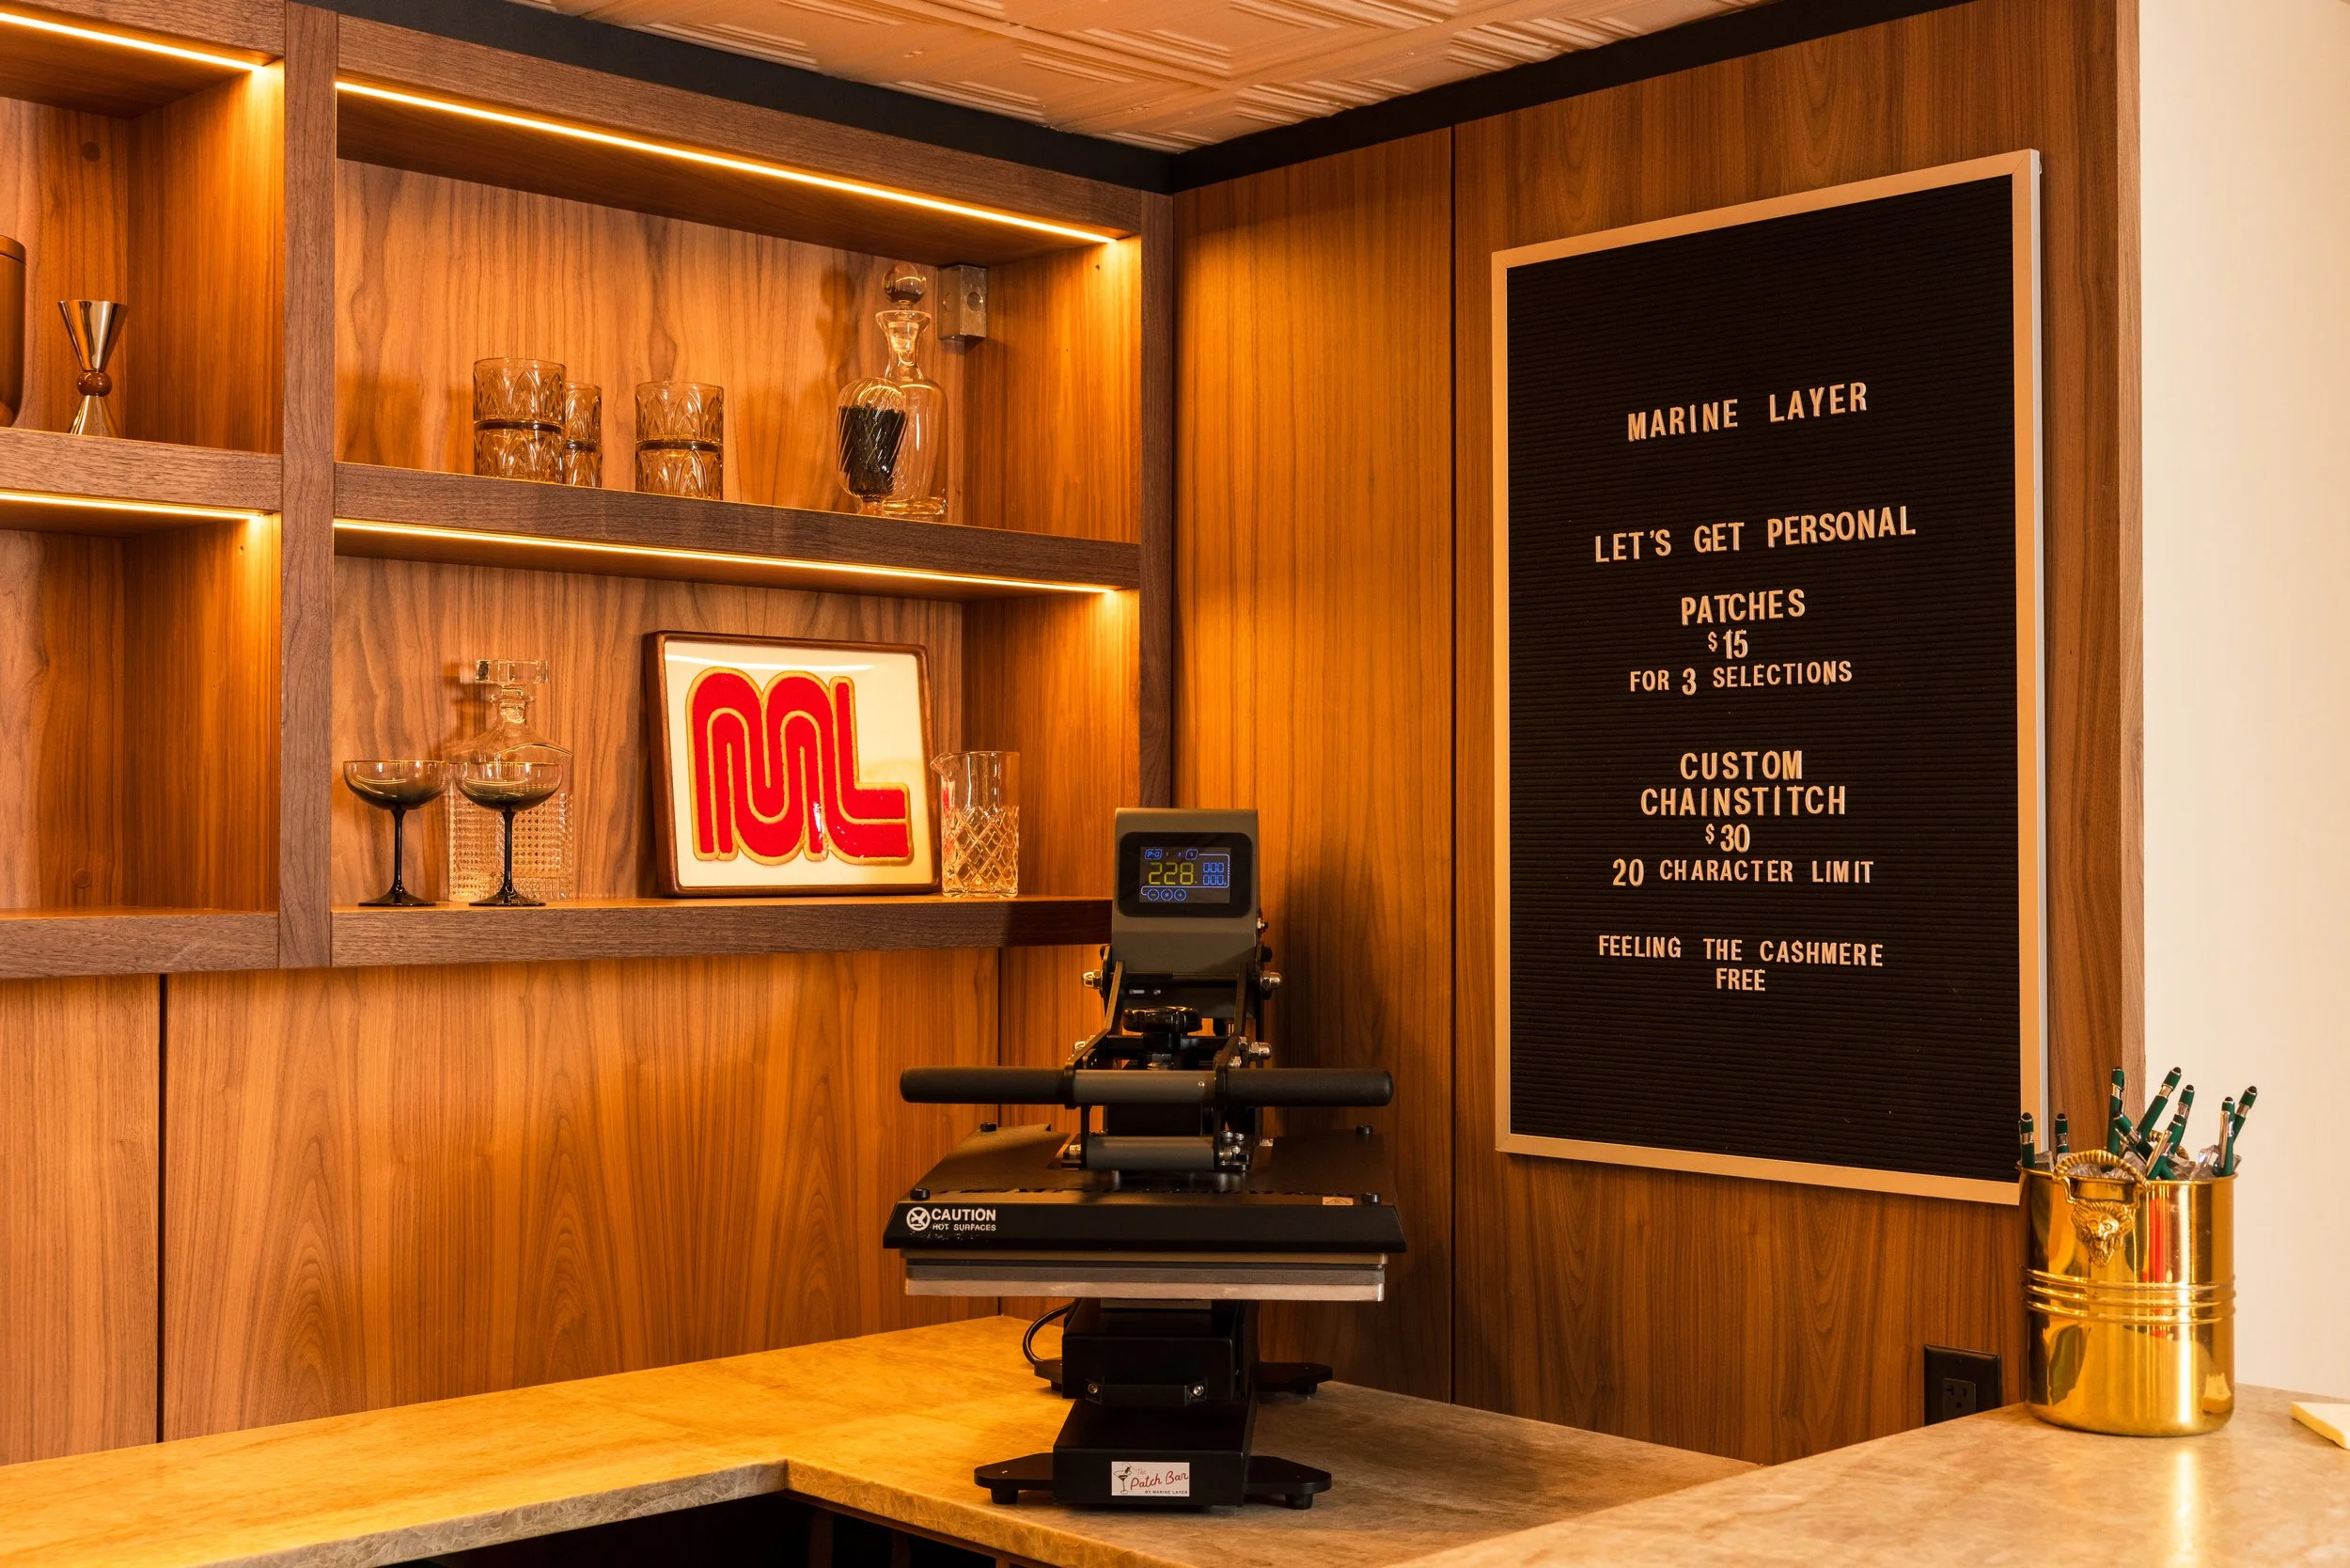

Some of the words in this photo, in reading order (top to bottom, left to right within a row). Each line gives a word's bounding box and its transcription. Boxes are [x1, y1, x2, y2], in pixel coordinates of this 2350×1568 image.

[1628, 399, 1738, 442] MARINE
[1770, 382, 1867, 422] LAYER
[1595, 529, 1671, 562] LET'S
[1694, 522, 1745, 553] GET
[1768, 506, 1916, 548] PERSONAL
[1682, 588, 1805, 626] PATCHES
[1630, 669, 1669, 692] FOR
[1682, 667, 1697, 696] 3
[1713, 661, 1852, 688] SELECTIONS
[1681, 750, 1802, 780] CUSTOM
[1641, 785, 1845, 817] CHAINSTITCH
[1149, 862, 1194, 885] 228
[1613, 858, 1644, 886] 20
[1660, 859, 1793, 882] CHARACTER
[1812, 860, 1873, 883] LIMIT
[1599, 935, 1681, 958] FEELING
[1703, 938, 1742, 961] THE
[1760, 940, 1883, 966] CASHMERE
[1716, 967, 1765, 991] FREE
[932, 1208, 996, 1221] CAUTION
[953, 1223, 996, 1231] SURFACES
[1130, 1474, 1162, 1491] Patch
[1166, 1470, 1189, 1484] Bar
